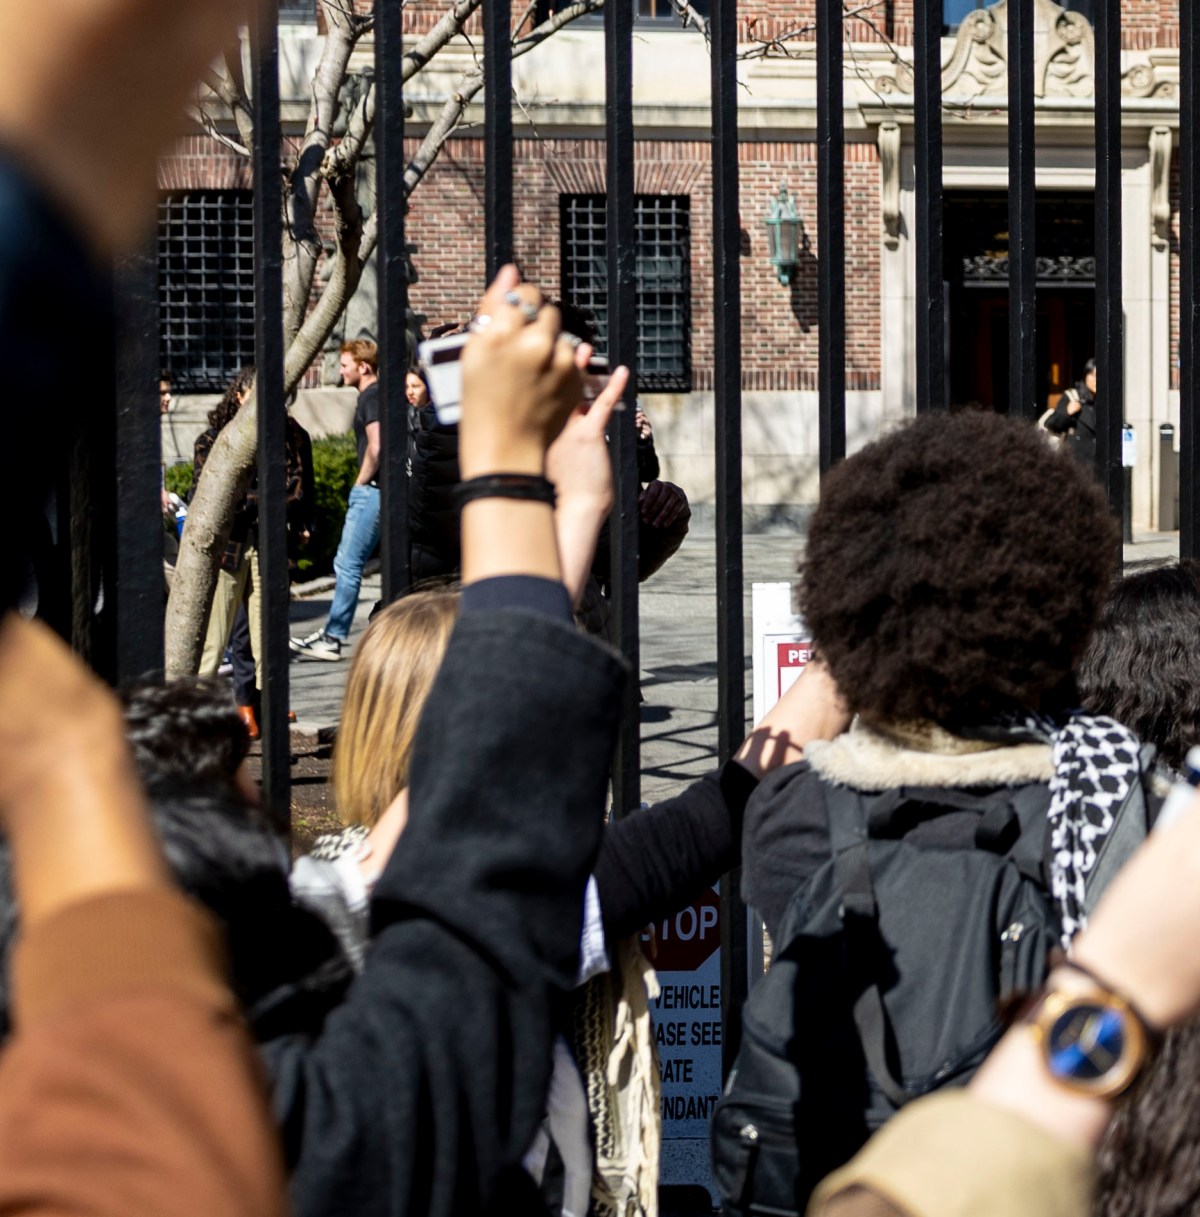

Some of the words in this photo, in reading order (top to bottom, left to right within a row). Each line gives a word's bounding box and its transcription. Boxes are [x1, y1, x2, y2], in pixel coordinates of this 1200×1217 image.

[641, 905, 719, 941] OP
[655, 985, 721, 1009] VEHICLE
[656, 1022, 687, 1046] ASE
[691, 1022, 722, 1046] SEE
[661, 1096, 718, 1120] NDANT
